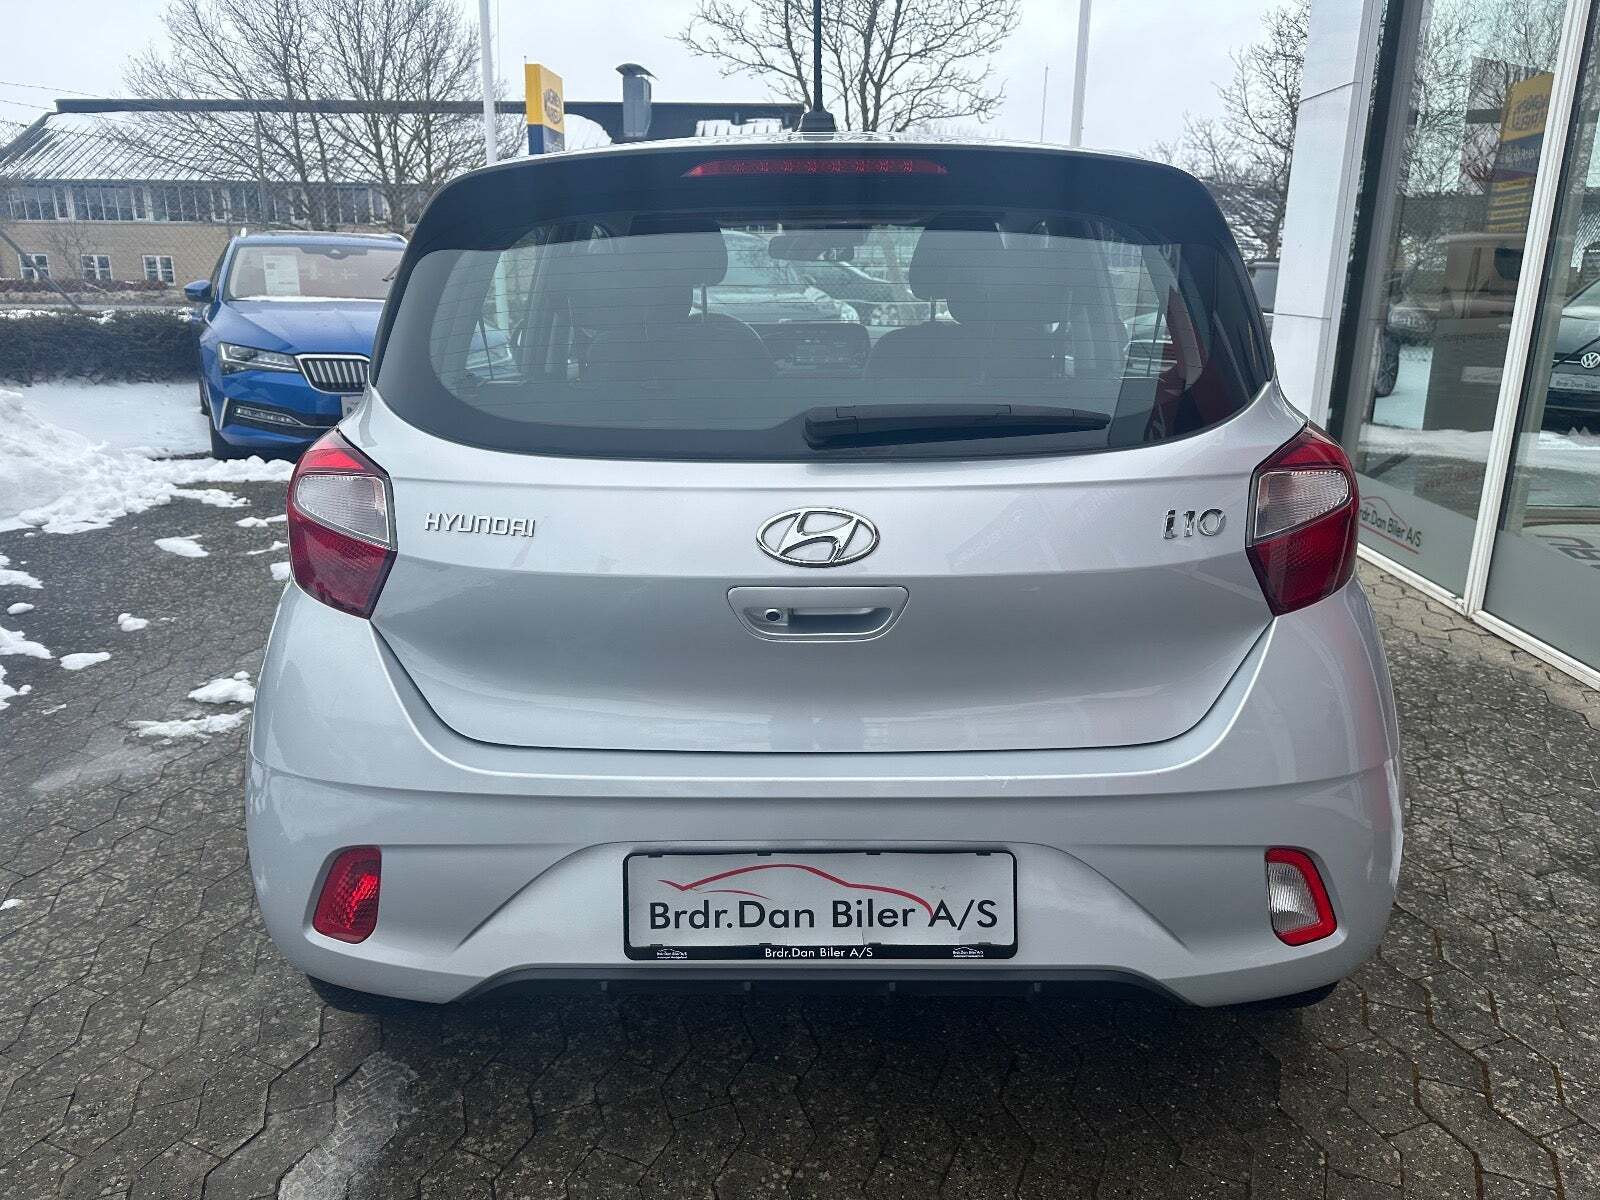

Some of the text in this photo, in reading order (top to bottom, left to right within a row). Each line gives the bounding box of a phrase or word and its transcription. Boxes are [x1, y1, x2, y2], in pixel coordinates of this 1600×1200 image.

[425, 512, 535, 538] HYUNDAI
[1163, 509, 1226, 539] i10
[1406, 527, 1423, 547] A/S
[649, 899, 998, 930] Brdr.Dan Biler A/S
[765, 947, 873, 958] Brdr.Dan Biler A/S
